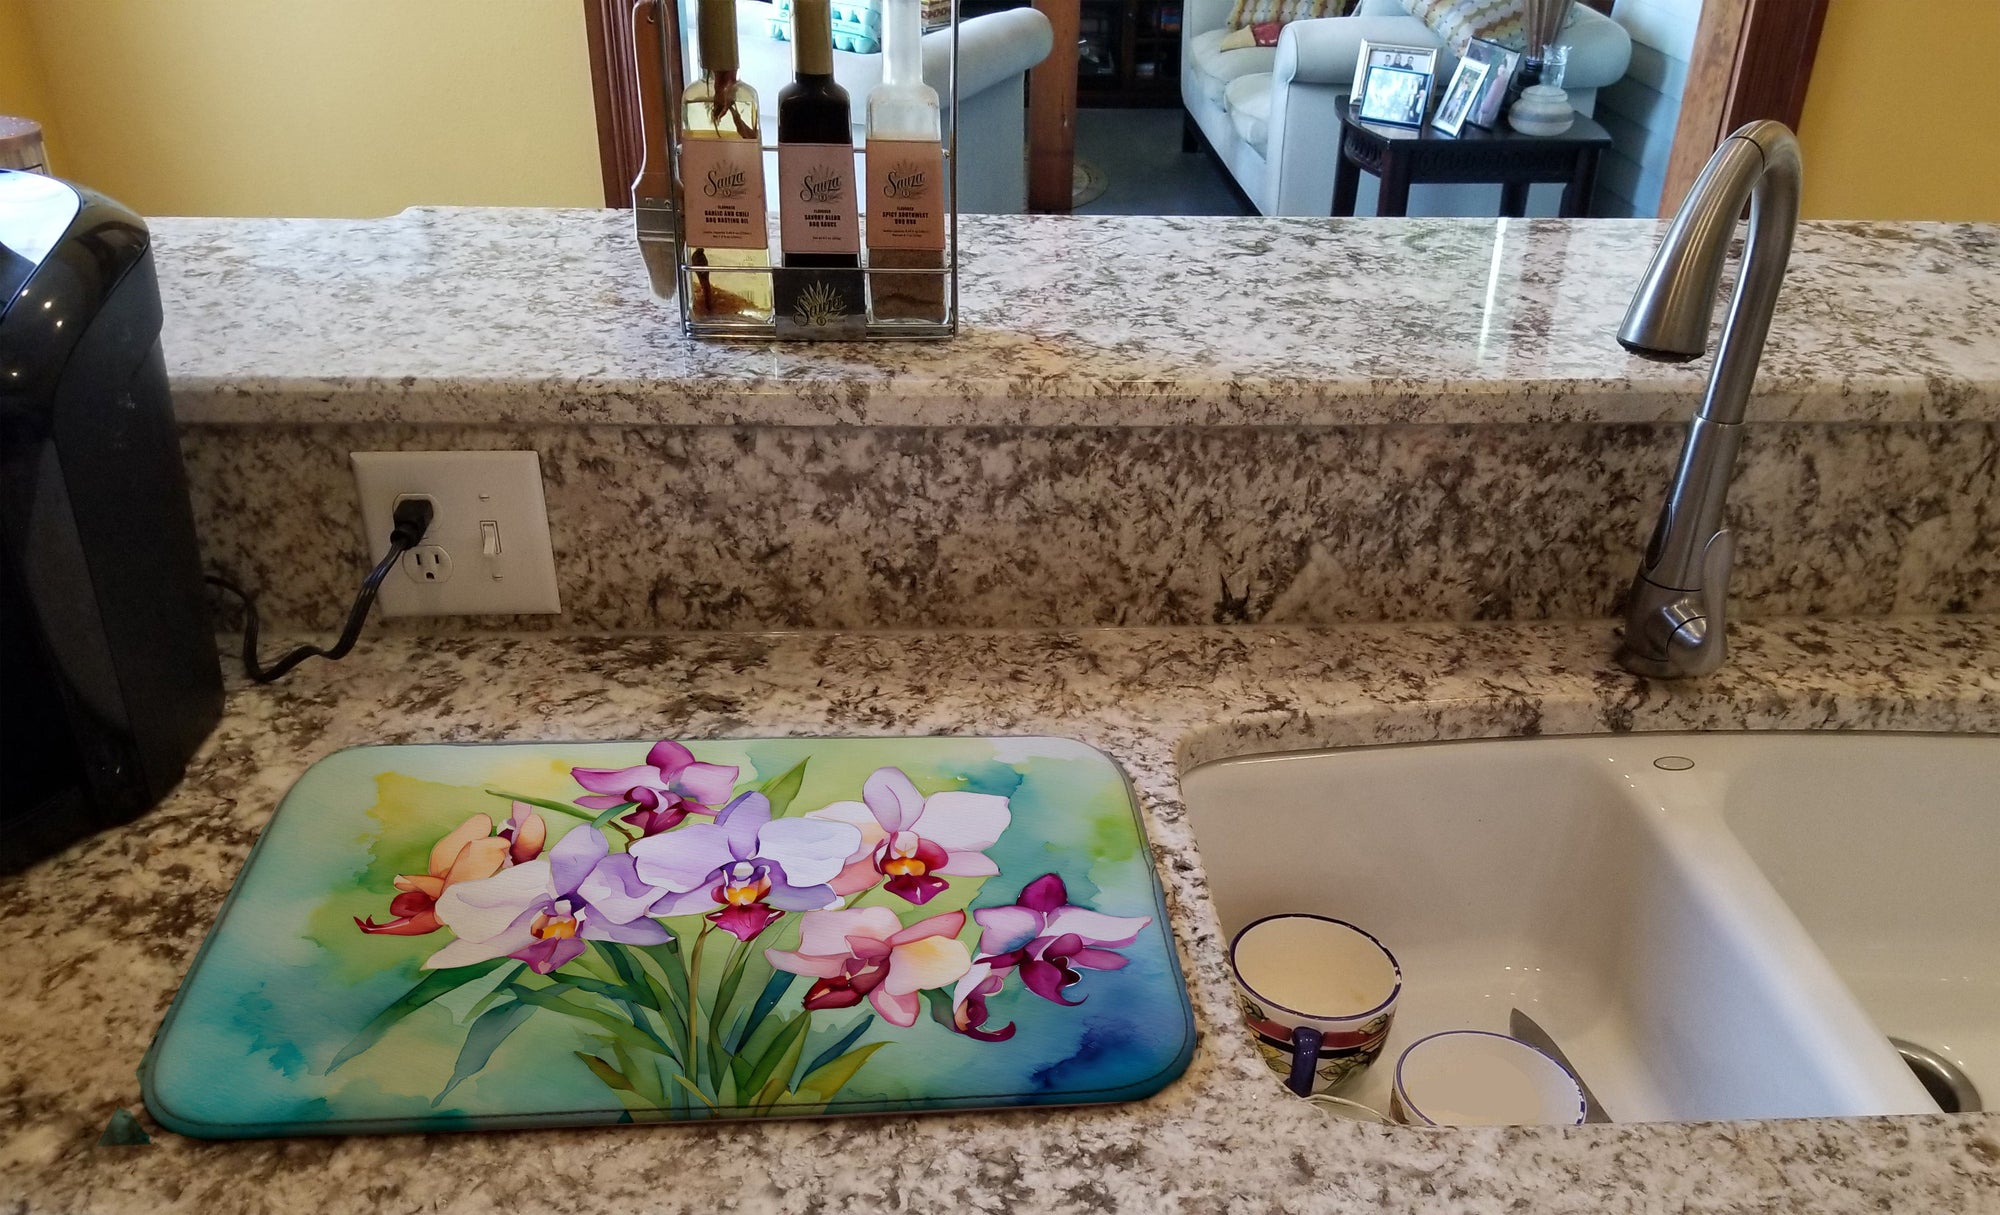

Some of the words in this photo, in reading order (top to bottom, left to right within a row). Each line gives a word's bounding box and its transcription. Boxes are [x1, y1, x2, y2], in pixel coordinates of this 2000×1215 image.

[703, 170, 746, 197] Sauza
[800, 175, 842, 202] Sauza
[884, 171, 925, 198] Sauza
[793, 295, 846, 327] Sauza
